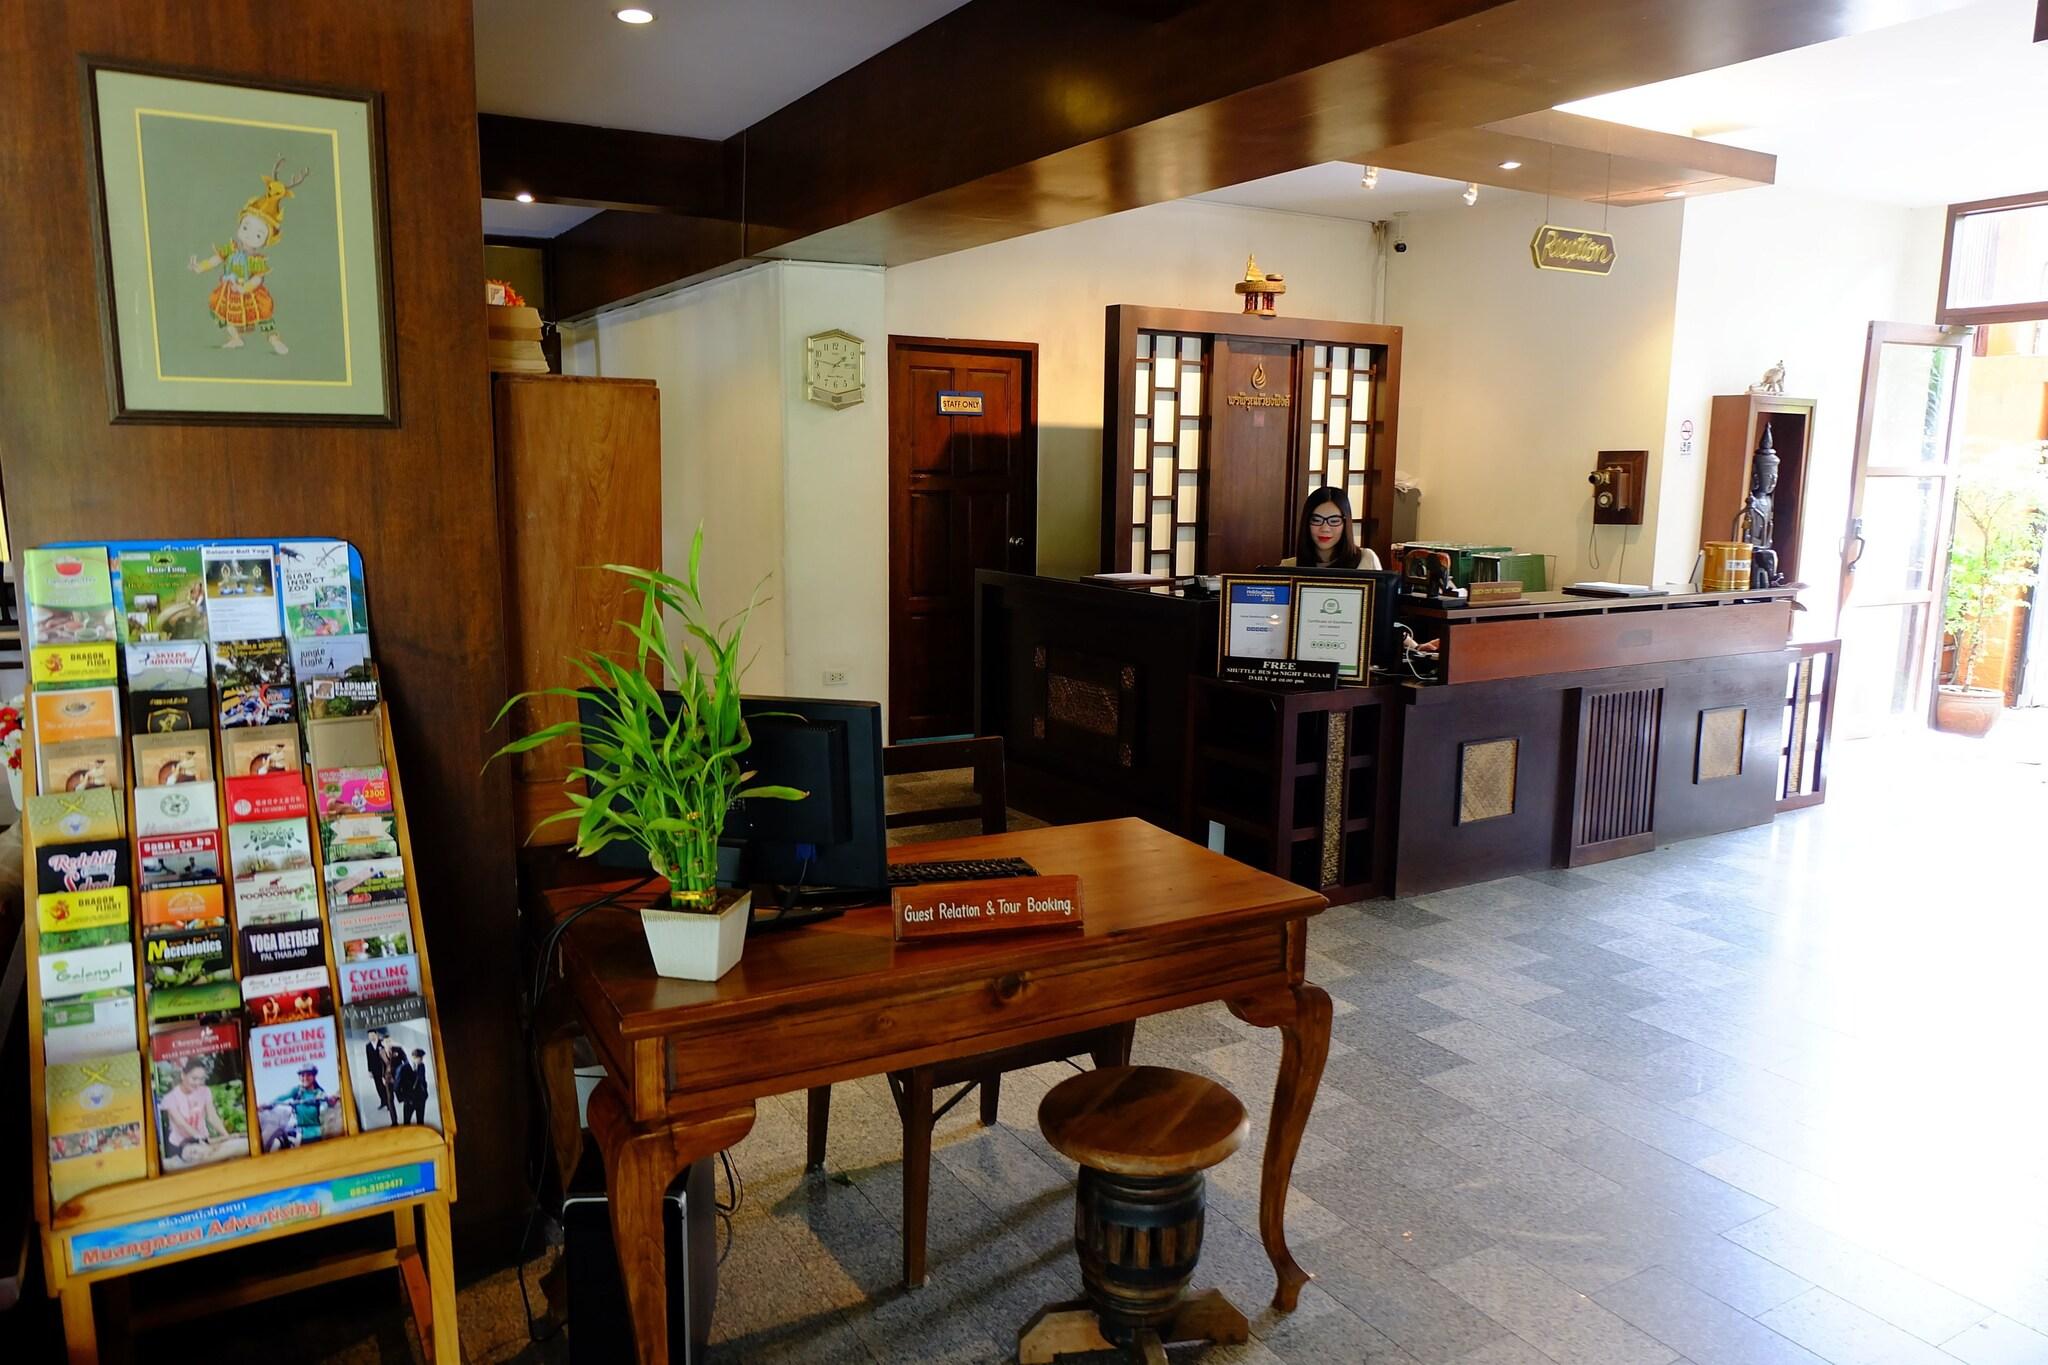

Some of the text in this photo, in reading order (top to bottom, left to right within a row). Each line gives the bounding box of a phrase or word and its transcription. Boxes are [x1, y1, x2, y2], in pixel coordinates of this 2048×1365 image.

[942, 399, 980, 409] STAFF ONLY
[287, 576, 325, 587] INSECT
[288, 585, 309, 593] ZOO
[70, 652, 104, 662] DRAGON
[86, 659, 111, 668] FLIGHT
[1262, 661, 1297, 670] FREE
[1226, 667, 1256, 675] SHUTTLE
[334, 681, 377, 691] ELEPHANT
[240, 887, 304, 901] POOPOOPAPER
[78, 895, 115, 907] DRAGON
[96, 903, 121, 912] FLIGHT
[904, 904, 934, 922] Guest
[939, 902, 980, 919] Relation
[986, 900, 995, 916] &
[997, 899, 1021, 914] Tour
[250, 928, 319, 953] YOGA RETREAT
[148, 939, 222, 962] Macrobiotics
[275, 948, 308, 960] THAILAND
[56, 961, 123, 983] Galangal
[207, 1200, 322, 1236] Advertising
